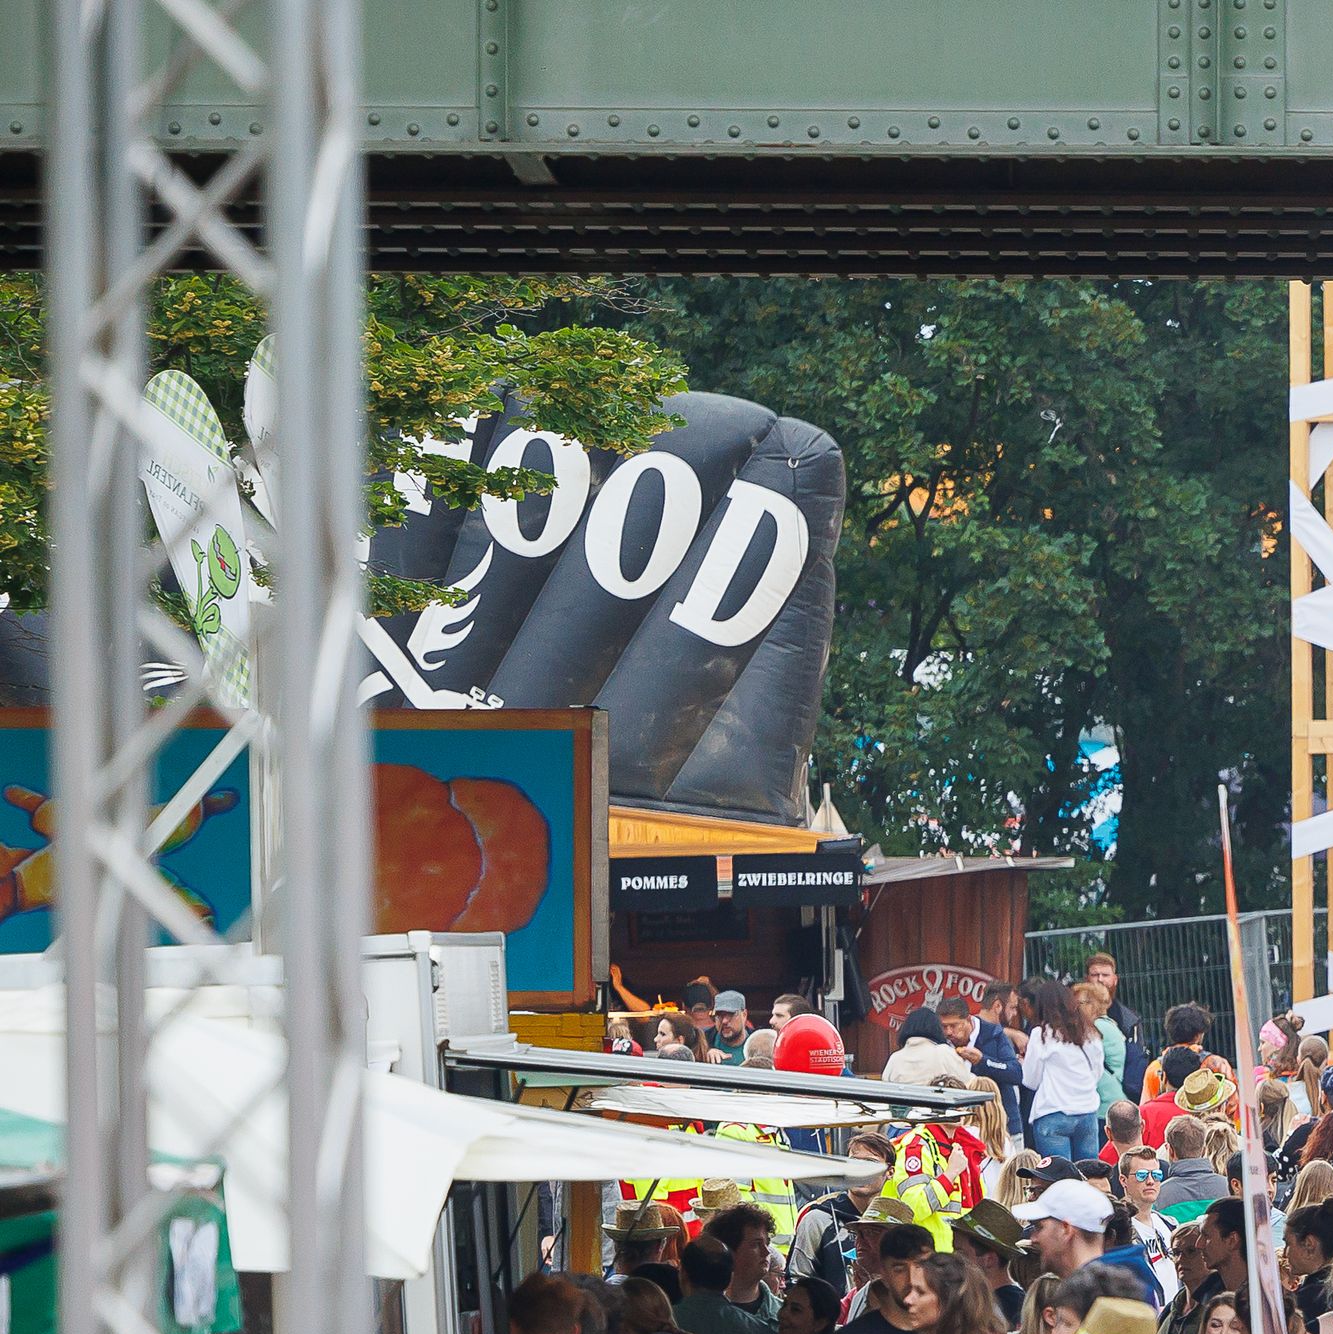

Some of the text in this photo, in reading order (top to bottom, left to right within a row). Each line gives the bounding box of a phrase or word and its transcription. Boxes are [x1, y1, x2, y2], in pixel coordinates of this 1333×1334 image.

[621, 875, 689, 891] POMMES
[738, 871, 854, 887] ZWIEBELRINGE
[871, 972, 986, 1014] ROCK FOO
[809, 1049, 838, 1057] WIENER
